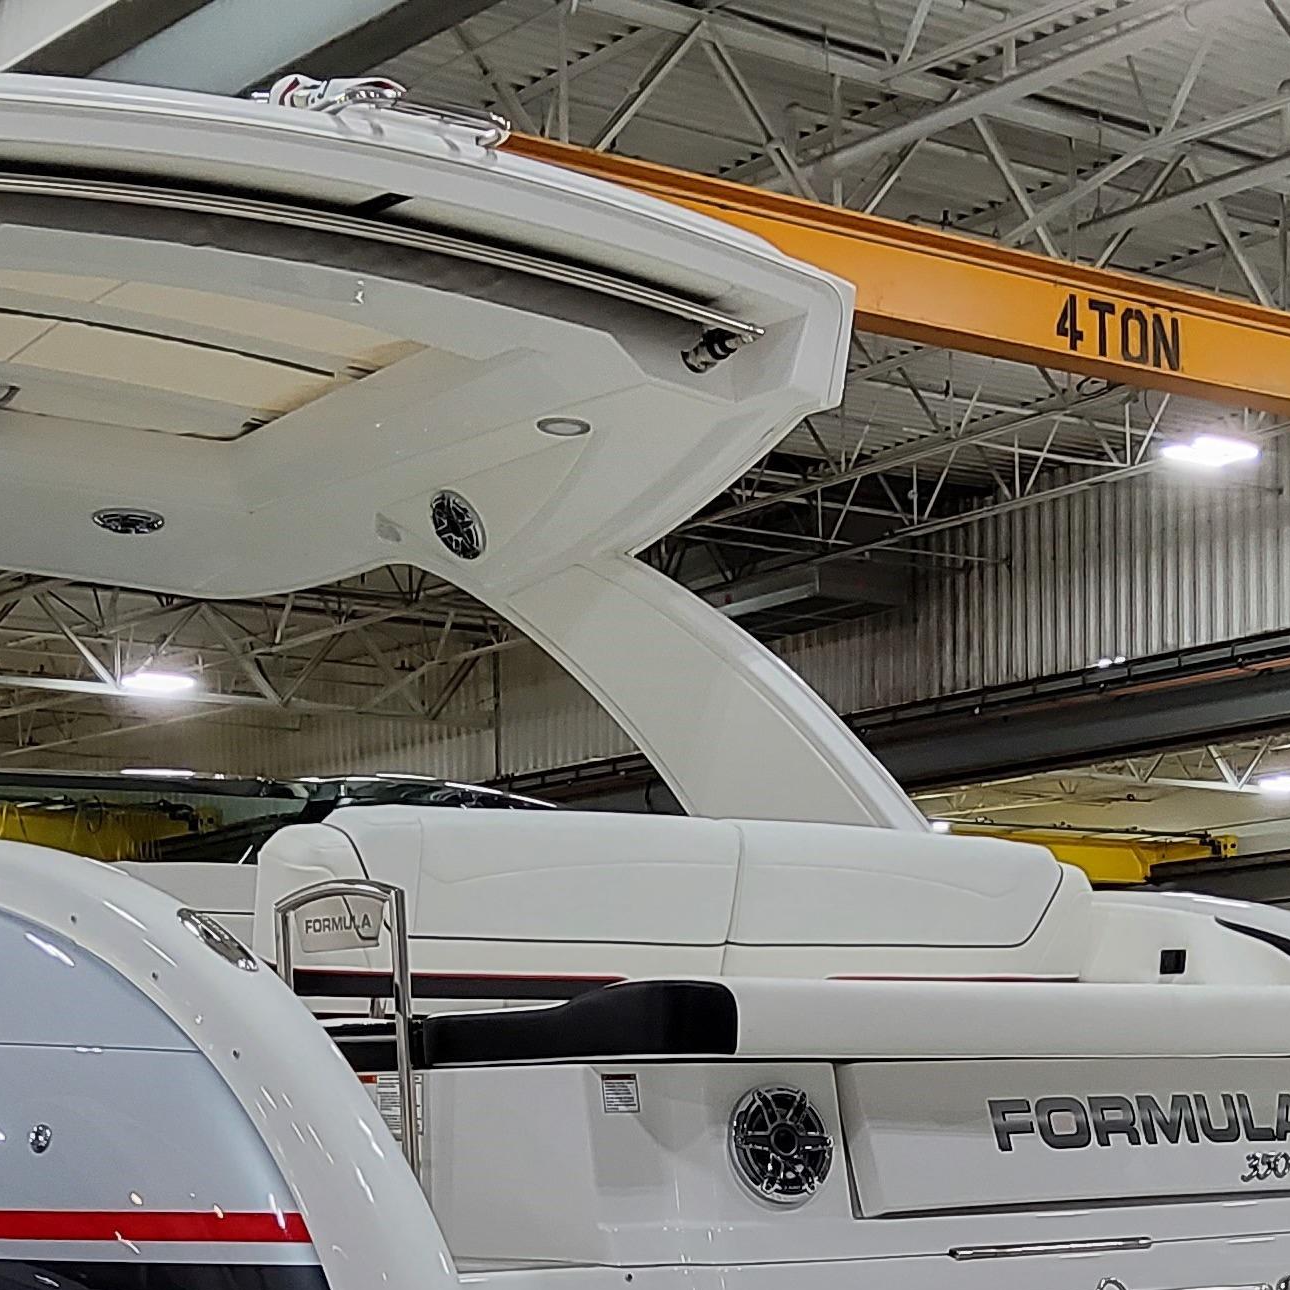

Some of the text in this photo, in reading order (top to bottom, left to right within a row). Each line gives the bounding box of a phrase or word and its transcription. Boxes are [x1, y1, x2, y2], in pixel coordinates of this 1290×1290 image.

[1056, 294, 1181, 372] 4 TON
[304, 913, 372, 934] FORMULA
[1240, 1151, 1290, 1183] 350
